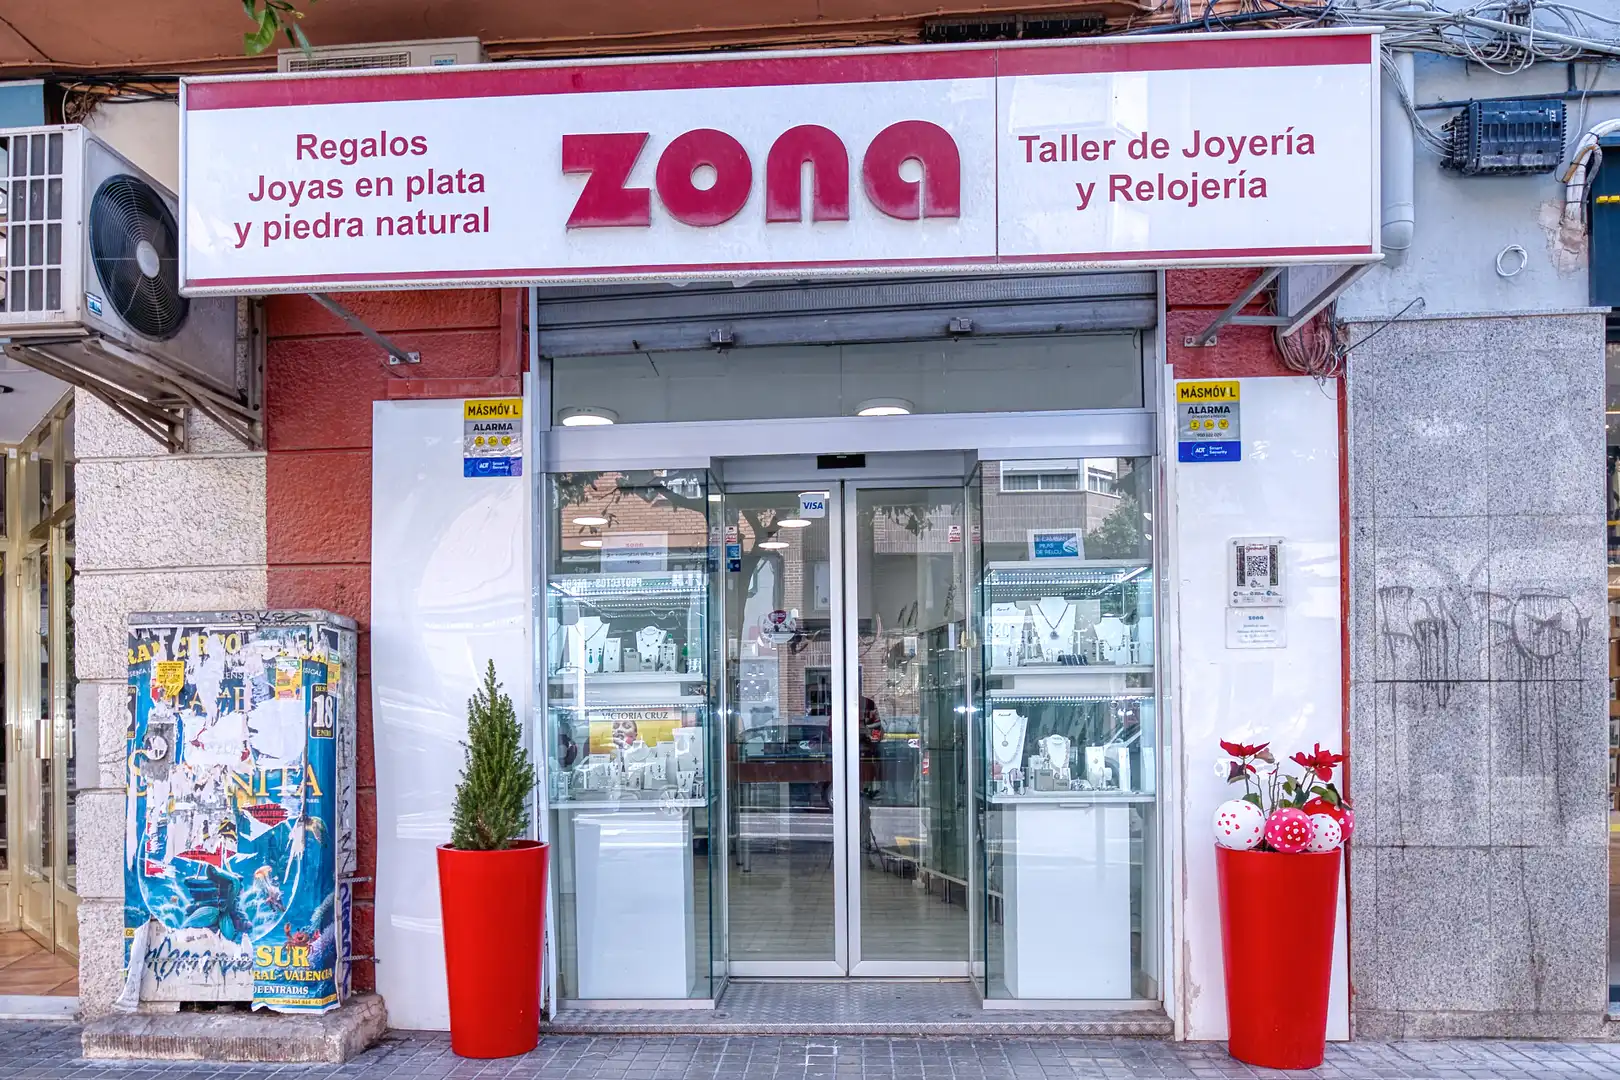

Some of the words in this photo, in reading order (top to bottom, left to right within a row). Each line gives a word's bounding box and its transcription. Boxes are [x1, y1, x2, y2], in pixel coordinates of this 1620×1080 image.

[296, 130, 428, 166] Regalos
[1018, 133, 1116, 164] Taller
[1127, 131, 1170, 160] de
[1182, 126, 1316, 165] Joyería
[248, 174, 344, 207] Joyas
[355, 176, 394, 198] en
[406, 168, 486, 203] plata
[1075, 181, 1096, 211] y
[1108, 169, 1269, 208] Relojería
[234, 219, 252, 249] y
[263, 212, 364, 248] piedra
[376, 206, 490, 237] natural
[1188, 406, 1231, 415] ALARMA
[473, 423, 513, 431] ALARMA
[803, 501, 824, 511] VISA
[313, 693, 333, 728] 18
[602, 712, 643, 720] VICTORIA
[645, 711, 669, 719] CRUZ
[255, 945, 310, 968] SUR
[284, 968, 333, 982] VALENCIA
[264, 986, 309, 995] ENTRADAS
